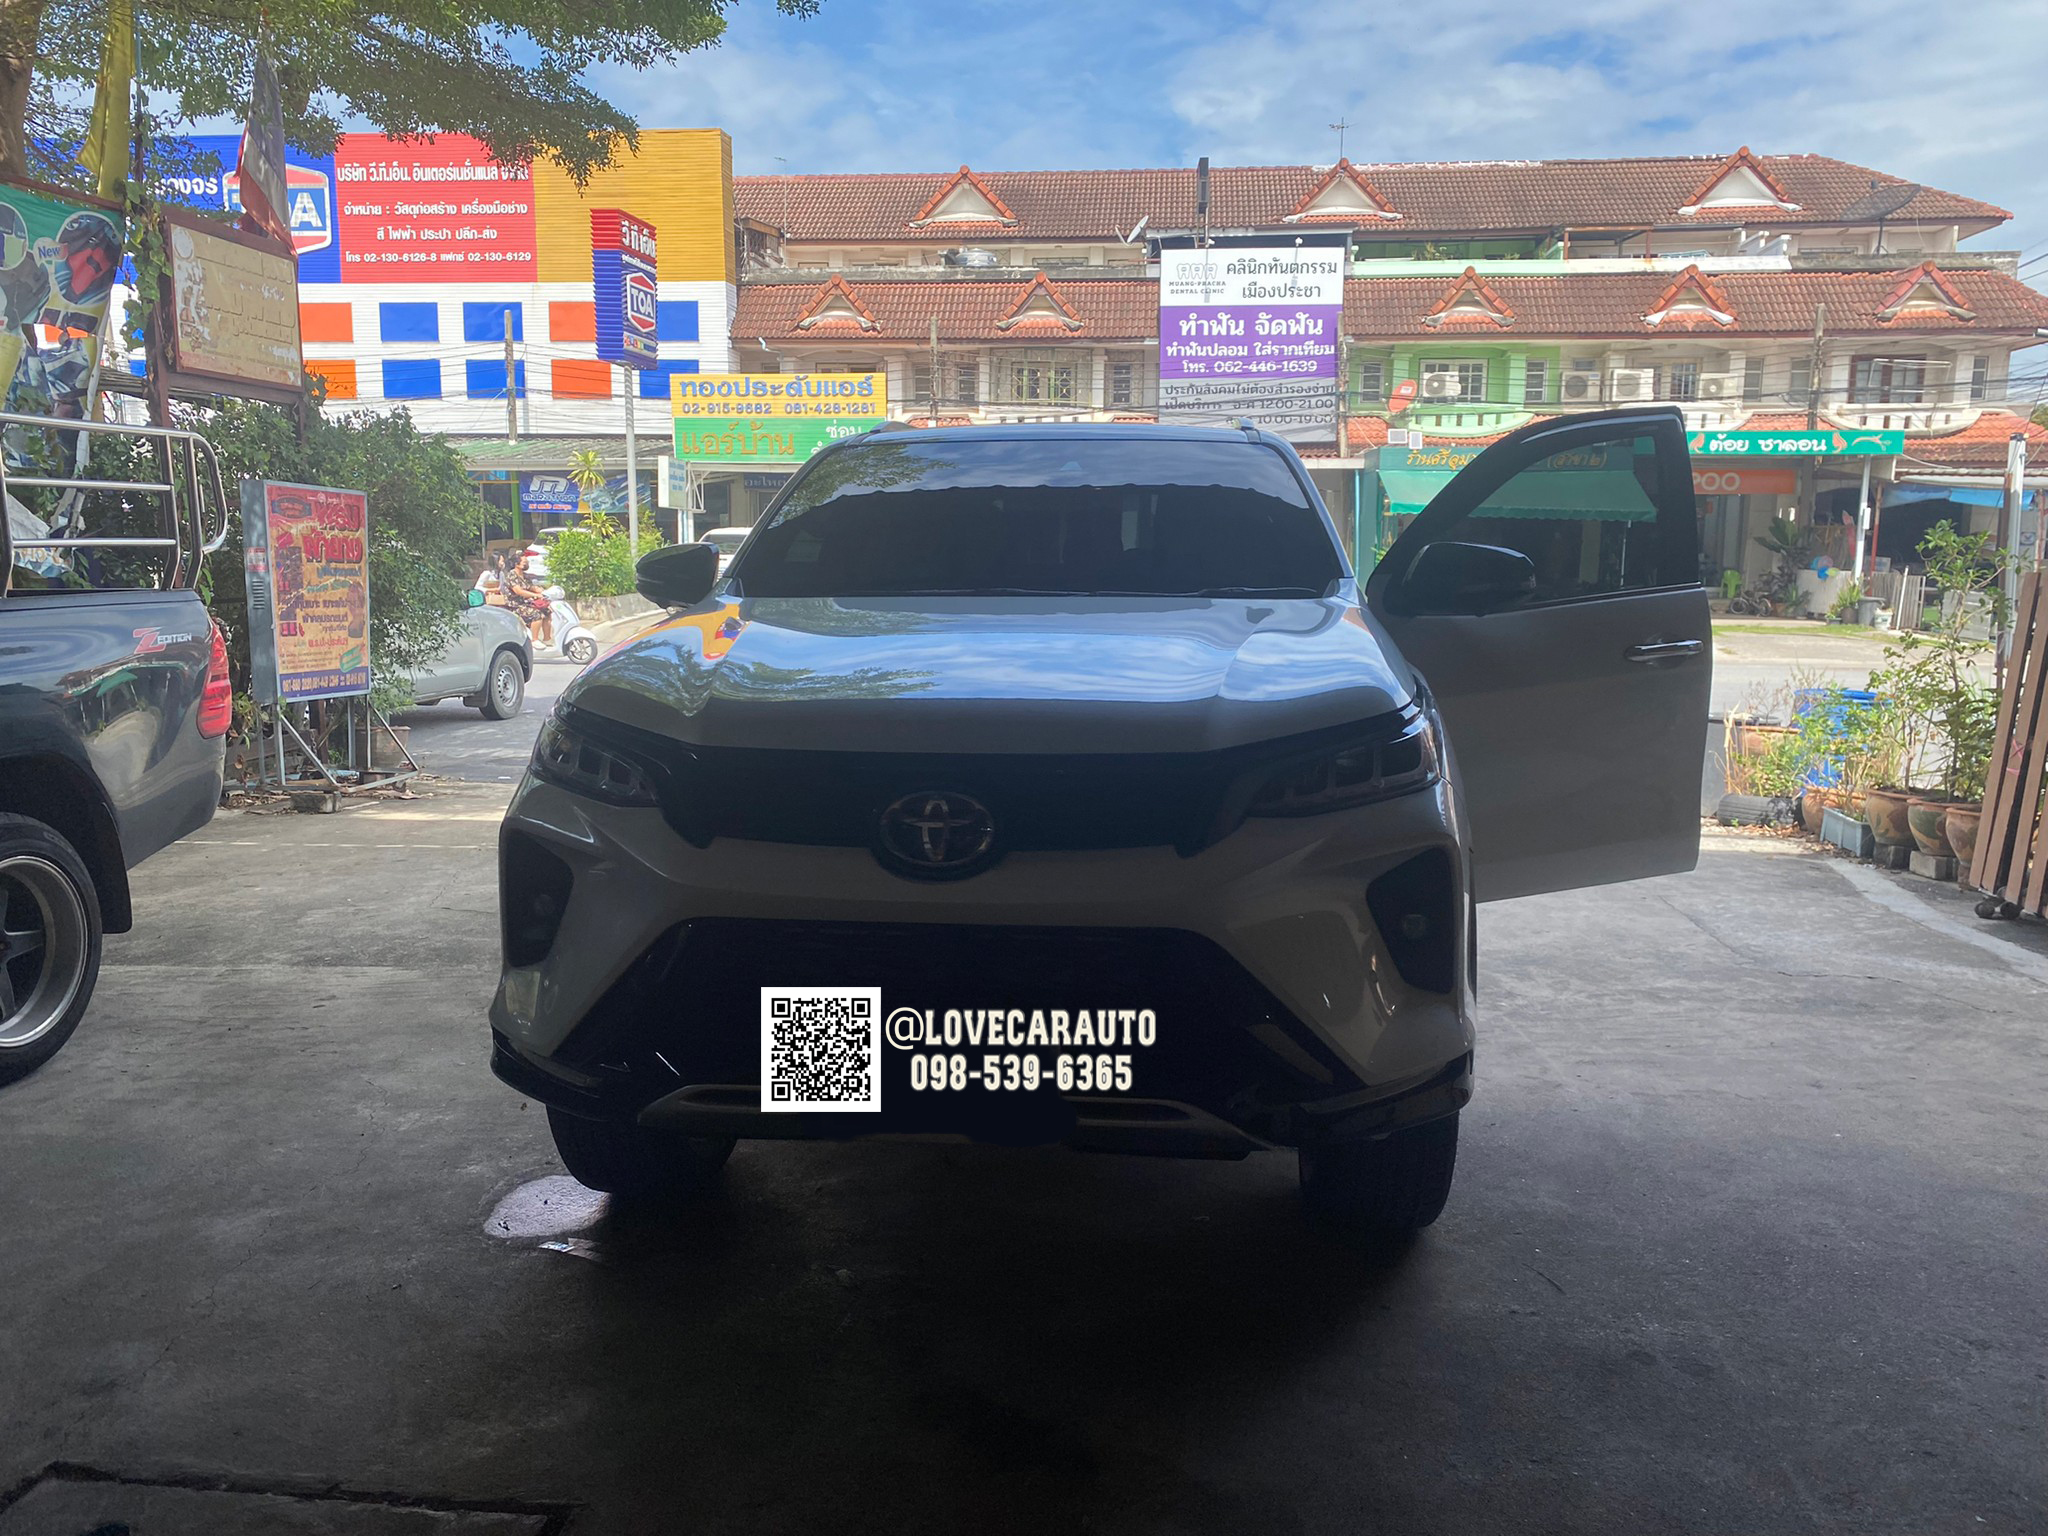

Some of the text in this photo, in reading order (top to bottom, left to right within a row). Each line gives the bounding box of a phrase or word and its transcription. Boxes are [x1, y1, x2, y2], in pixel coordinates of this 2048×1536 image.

[337, 162, 367, 182] บริษัท
[344, 202, 382, 215] จำหน่าย
[394, 201, 457, 218] วัสดุก่อสร้าง
[462, 198, 528, 215] เครื่องมือช่าง
[387, 225, 416, 240] ไฟฟ้า
[420, 228, 451, 240] ประปา
[38, 246, 60, 258] New
[364, 252, 437, 263] 02-130-6126-8
[468, 252, 531, 262] 02-130-6129
[1226, 257, 1337, 275] คลินิกทันตกรรม
[1242, 281, 1320, 298] เมืองประชา
[631, 288, 654, 317] TOA
[1179, 311, 1323, 336] ทำฟัน จัดฟัน
[1166, 341, 1248, 357] ทำฟันปลอม
[1182, 359, 1318, 373] โทร. 062-446-1639
[680, 375, 874, 397] ทองประดับแอร์
[682, 421, 795, 455] แอร์บ้าน
[1709, 434, 1827, 452] ต้อย ซาลอน
[157, 632, 192, 645] EDITION
